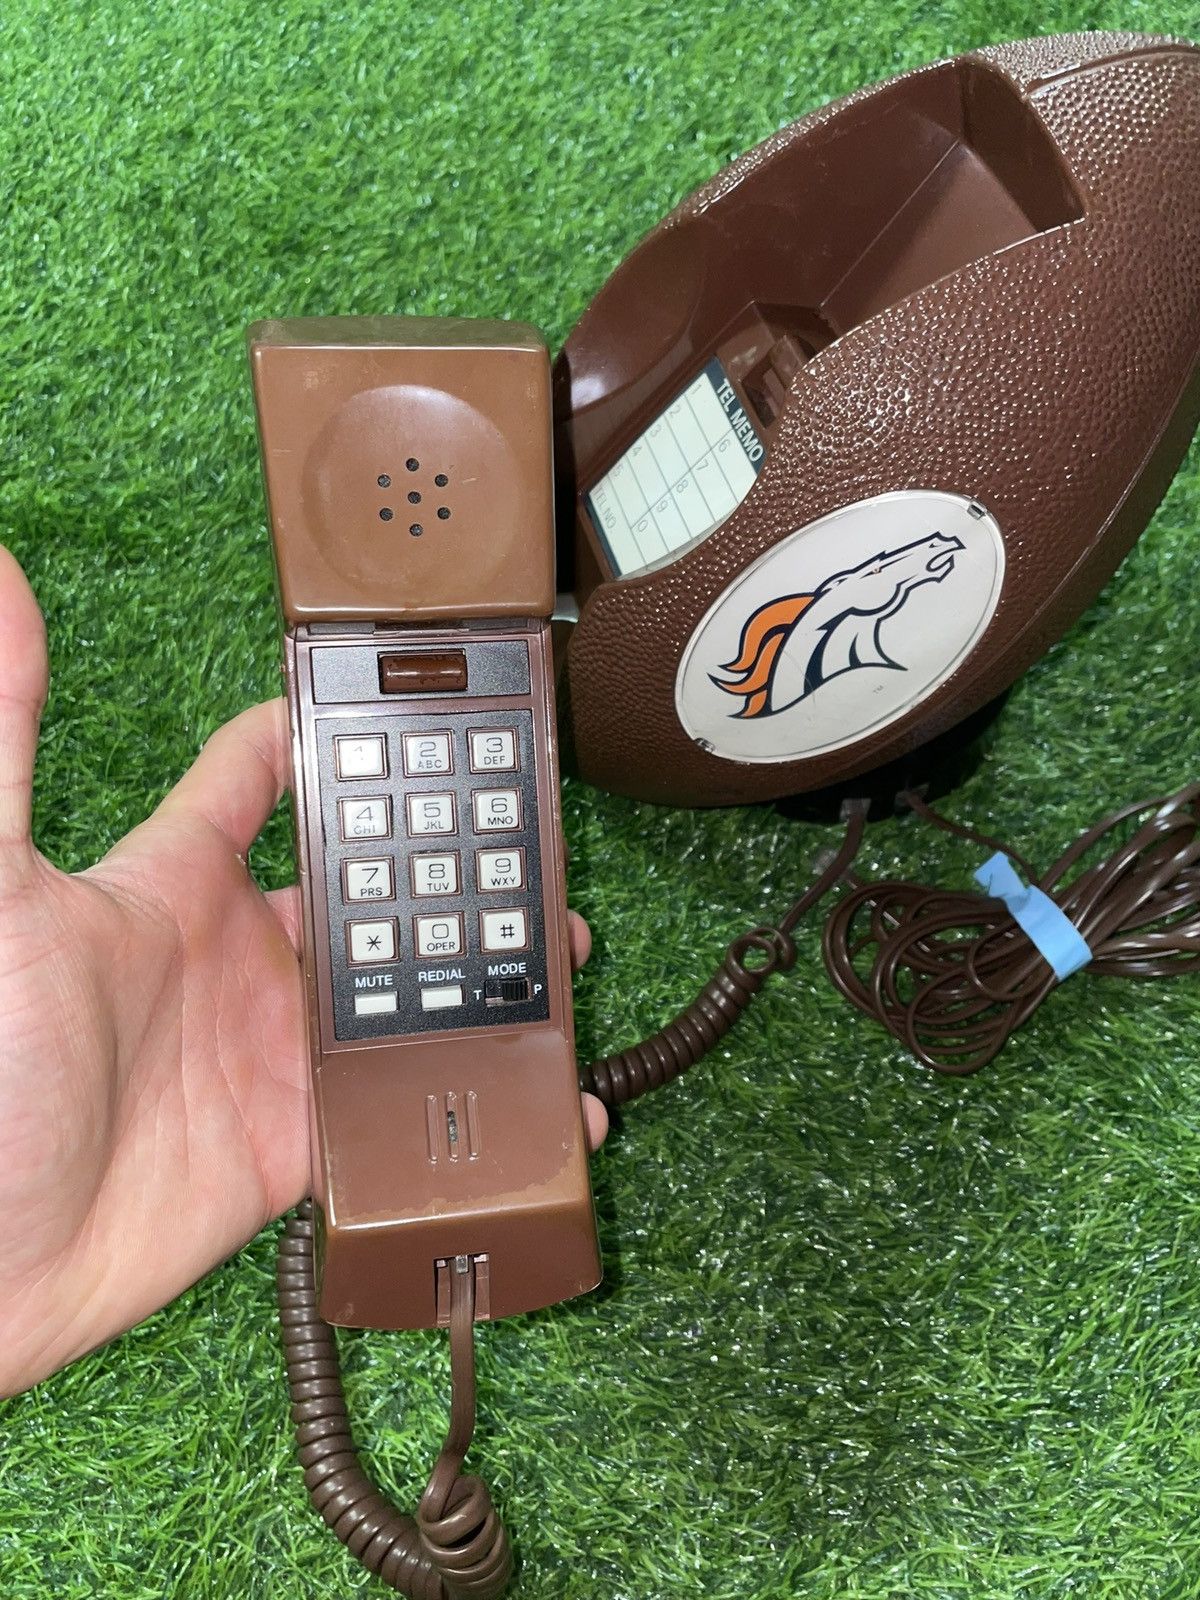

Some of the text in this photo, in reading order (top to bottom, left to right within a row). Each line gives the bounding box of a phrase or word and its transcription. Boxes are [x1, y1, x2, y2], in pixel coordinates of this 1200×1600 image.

[668, 404, 681, 418] 2
[716, 377, 764, 462] TEL MEMO
[649, 424, 662, 438] 3
[631, 445, 643, 457] 4
[718, 439, 731, 453] 6
[696, 460, 709, 471] 7
[676, 480, 689, 494] 8
[657, 499, 669, 513] 9
[419, 741, 437, 757] 2
[486, 737, 503, 753] 3
[417, 759, 442, 770] ABC
[483, 755, 506, 766] DEF
[423, 802, 441, 818] 5
[491, 797, 508, 813] 6
[356, 806, 374, 822] 4
[487, 815, 514, 826] MNO
[424, 819, 444, 831] JKL
[428, 863, 446, 879] 8
[495, 857, 512, 874] 9
[361, 867, 379, 884] 7
[490, 876, 517, 887] WXY
[360, 886, 383, 897] PRS
[427, 882, 450, 892] TUV
[427, 941, 456, 952] OPER
[418, 968, 466, 983] REDIAL
[487, 962, 527, 976] MODE
[355, 974, 393, 989] MUTE
[474, 990, 483, 1001] T
[534, 984, 543, 996] P
